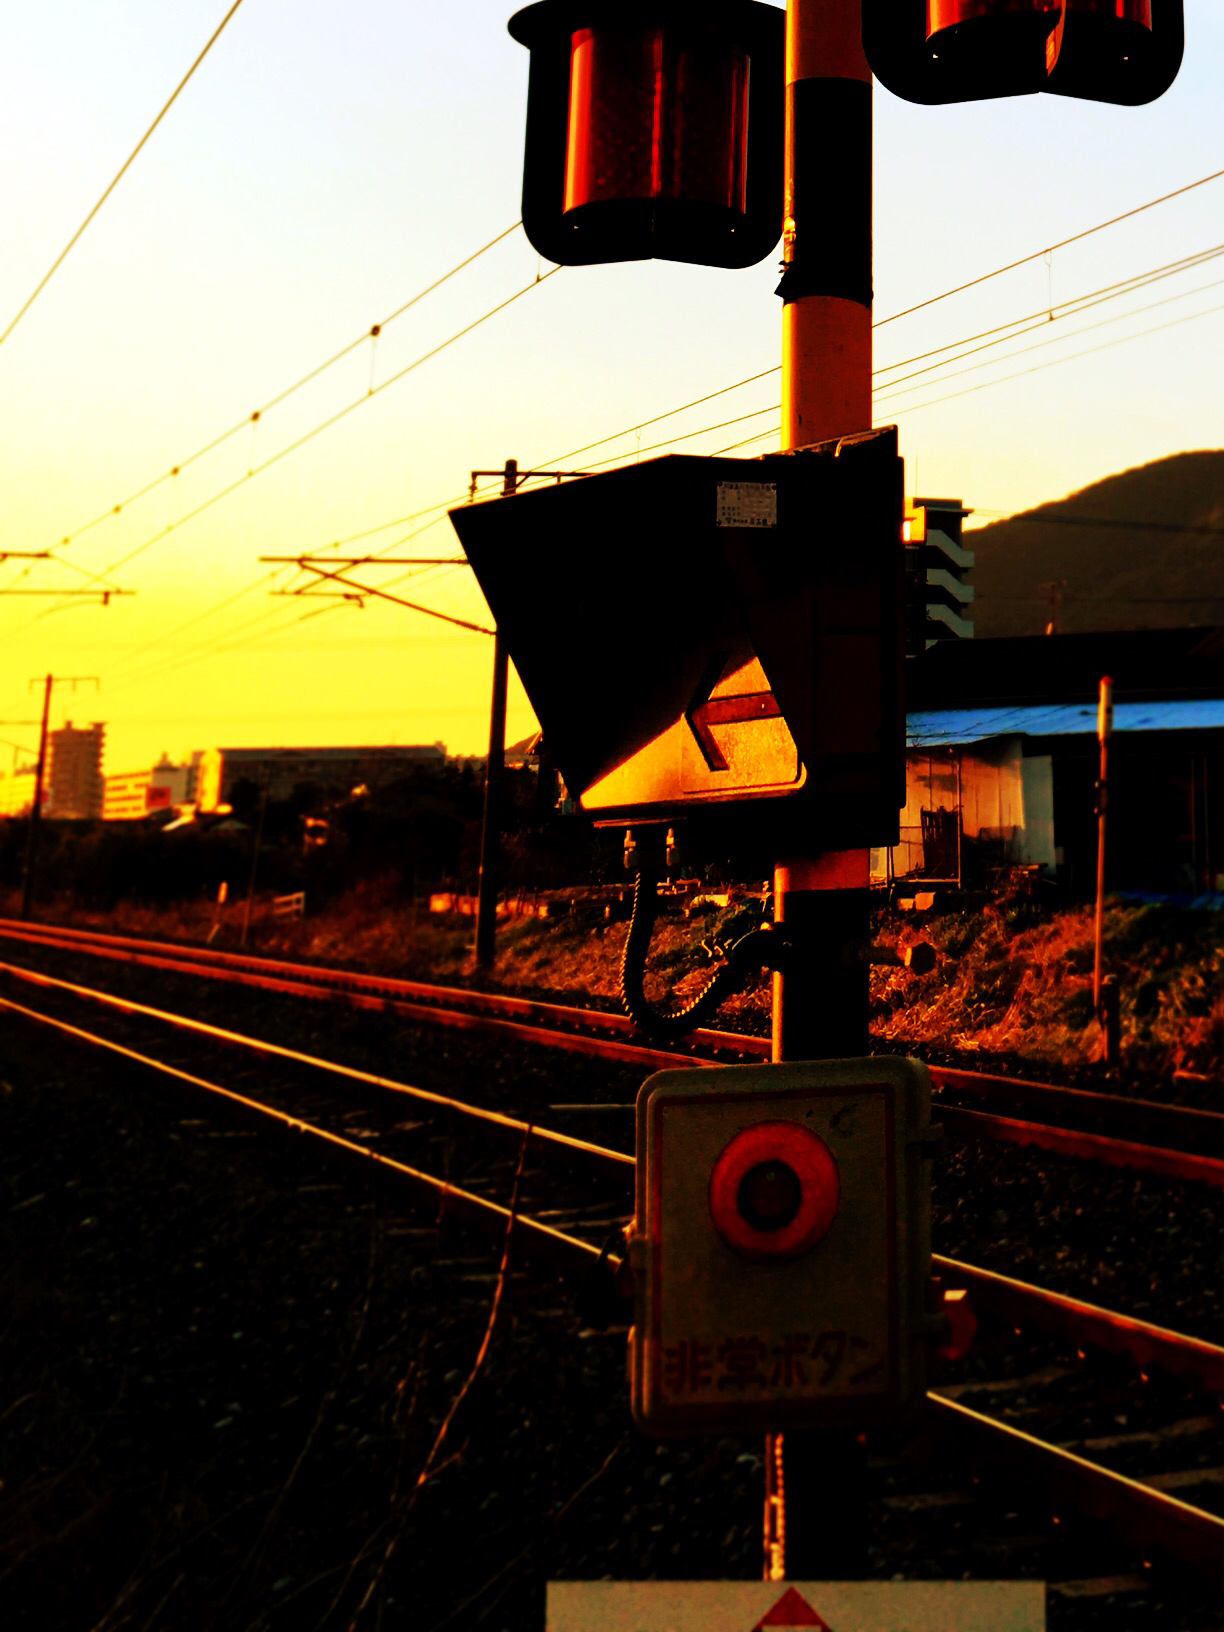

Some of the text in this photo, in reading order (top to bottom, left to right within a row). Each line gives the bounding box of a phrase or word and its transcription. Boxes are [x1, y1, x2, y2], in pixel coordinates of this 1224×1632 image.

[665, 1330, 885, 1393] 非常ボタン
